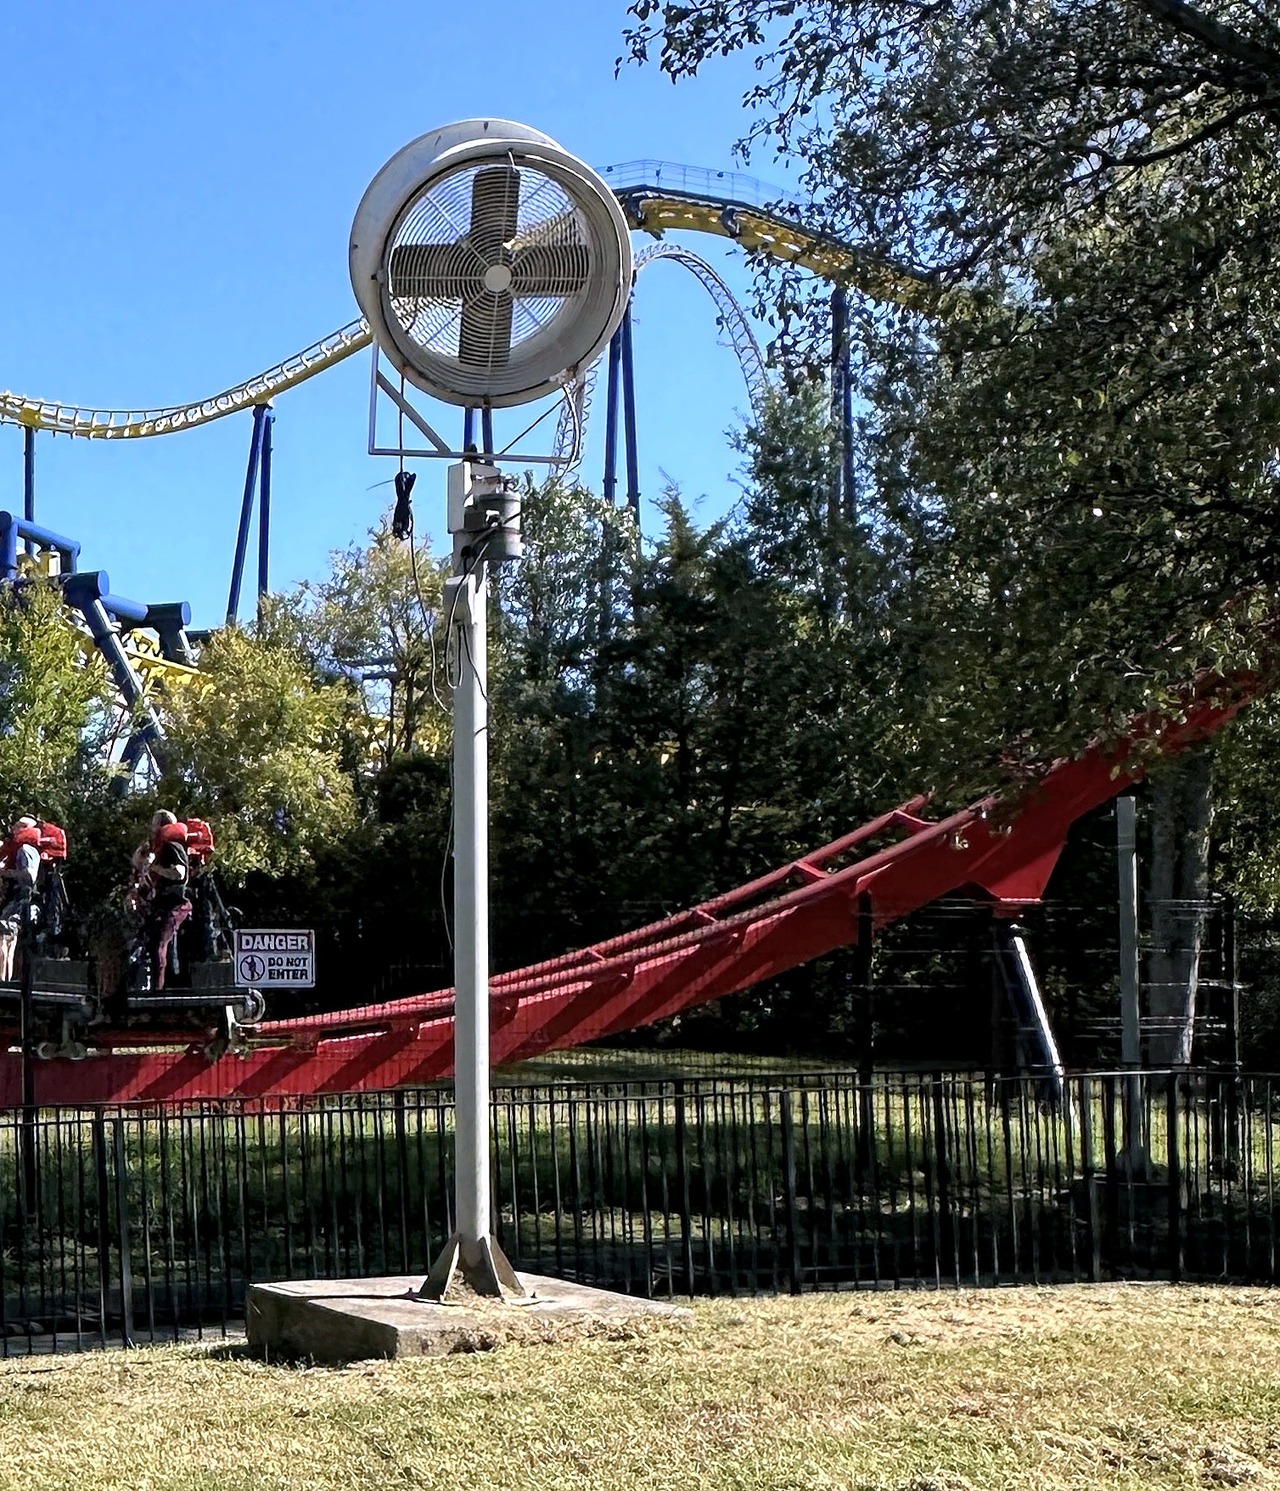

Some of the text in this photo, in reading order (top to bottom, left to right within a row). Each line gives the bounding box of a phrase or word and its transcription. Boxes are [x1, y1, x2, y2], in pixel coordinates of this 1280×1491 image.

[241, 934, 309, 950] DANGER
[268, 957, 309, 967] DO NOT
[268, 968, 308, 980] ENTER
